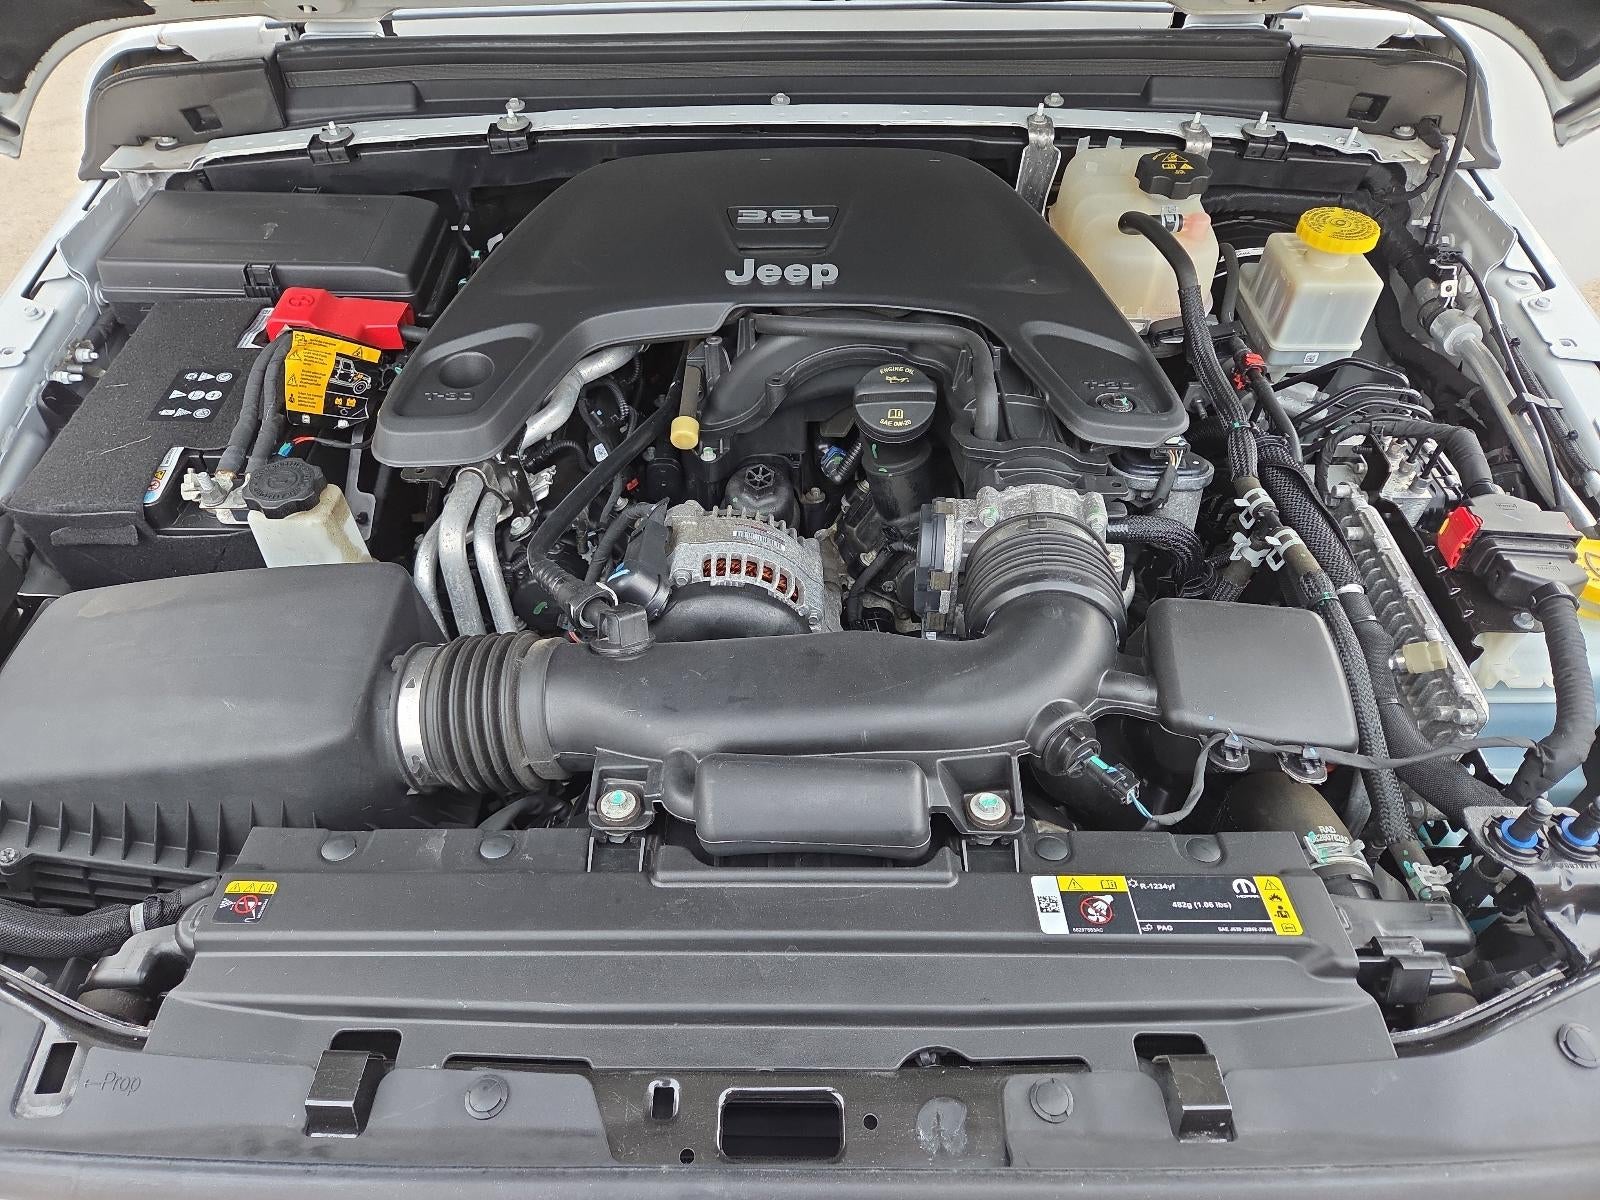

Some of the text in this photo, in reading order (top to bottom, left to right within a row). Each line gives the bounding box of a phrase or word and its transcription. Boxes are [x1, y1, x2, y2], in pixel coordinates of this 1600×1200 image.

[737, 209, 830, 224] 3.6L
[724, 258, 839, 290] Jeep
[879, 366, 915, 376] ENGINE OIL
[879, 418, 893, 427] SAE
[1317, 825, 1337, 834] RAD
[1215, 901, 1232, 911] lbs)
[1157, 924, 1173, 932] PAG
[101, 1071, 142, 1097] Prop
